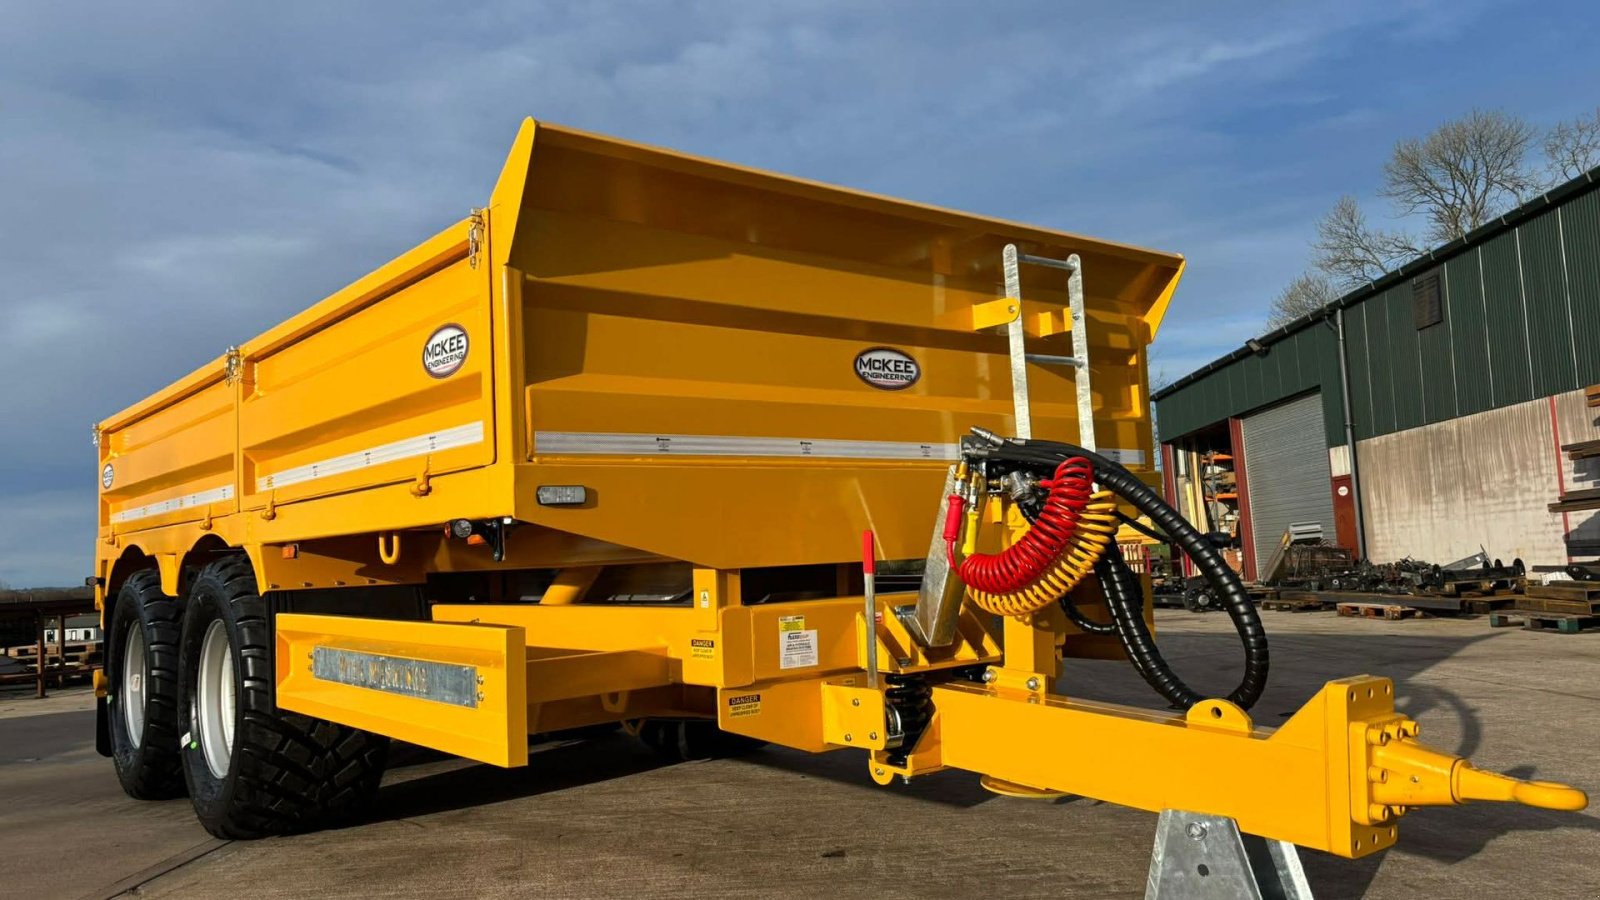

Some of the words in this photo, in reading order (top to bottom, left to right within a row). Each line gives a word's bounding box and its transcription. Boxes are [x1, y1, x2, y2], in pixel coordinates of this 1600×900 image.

[427, 351, 464, 369] ENGINEERING
[862, 371, 913, 382] ENGINEERING
[692, 640, 712, 648] DANGER
[731, 695, 758, 705] DANGER
